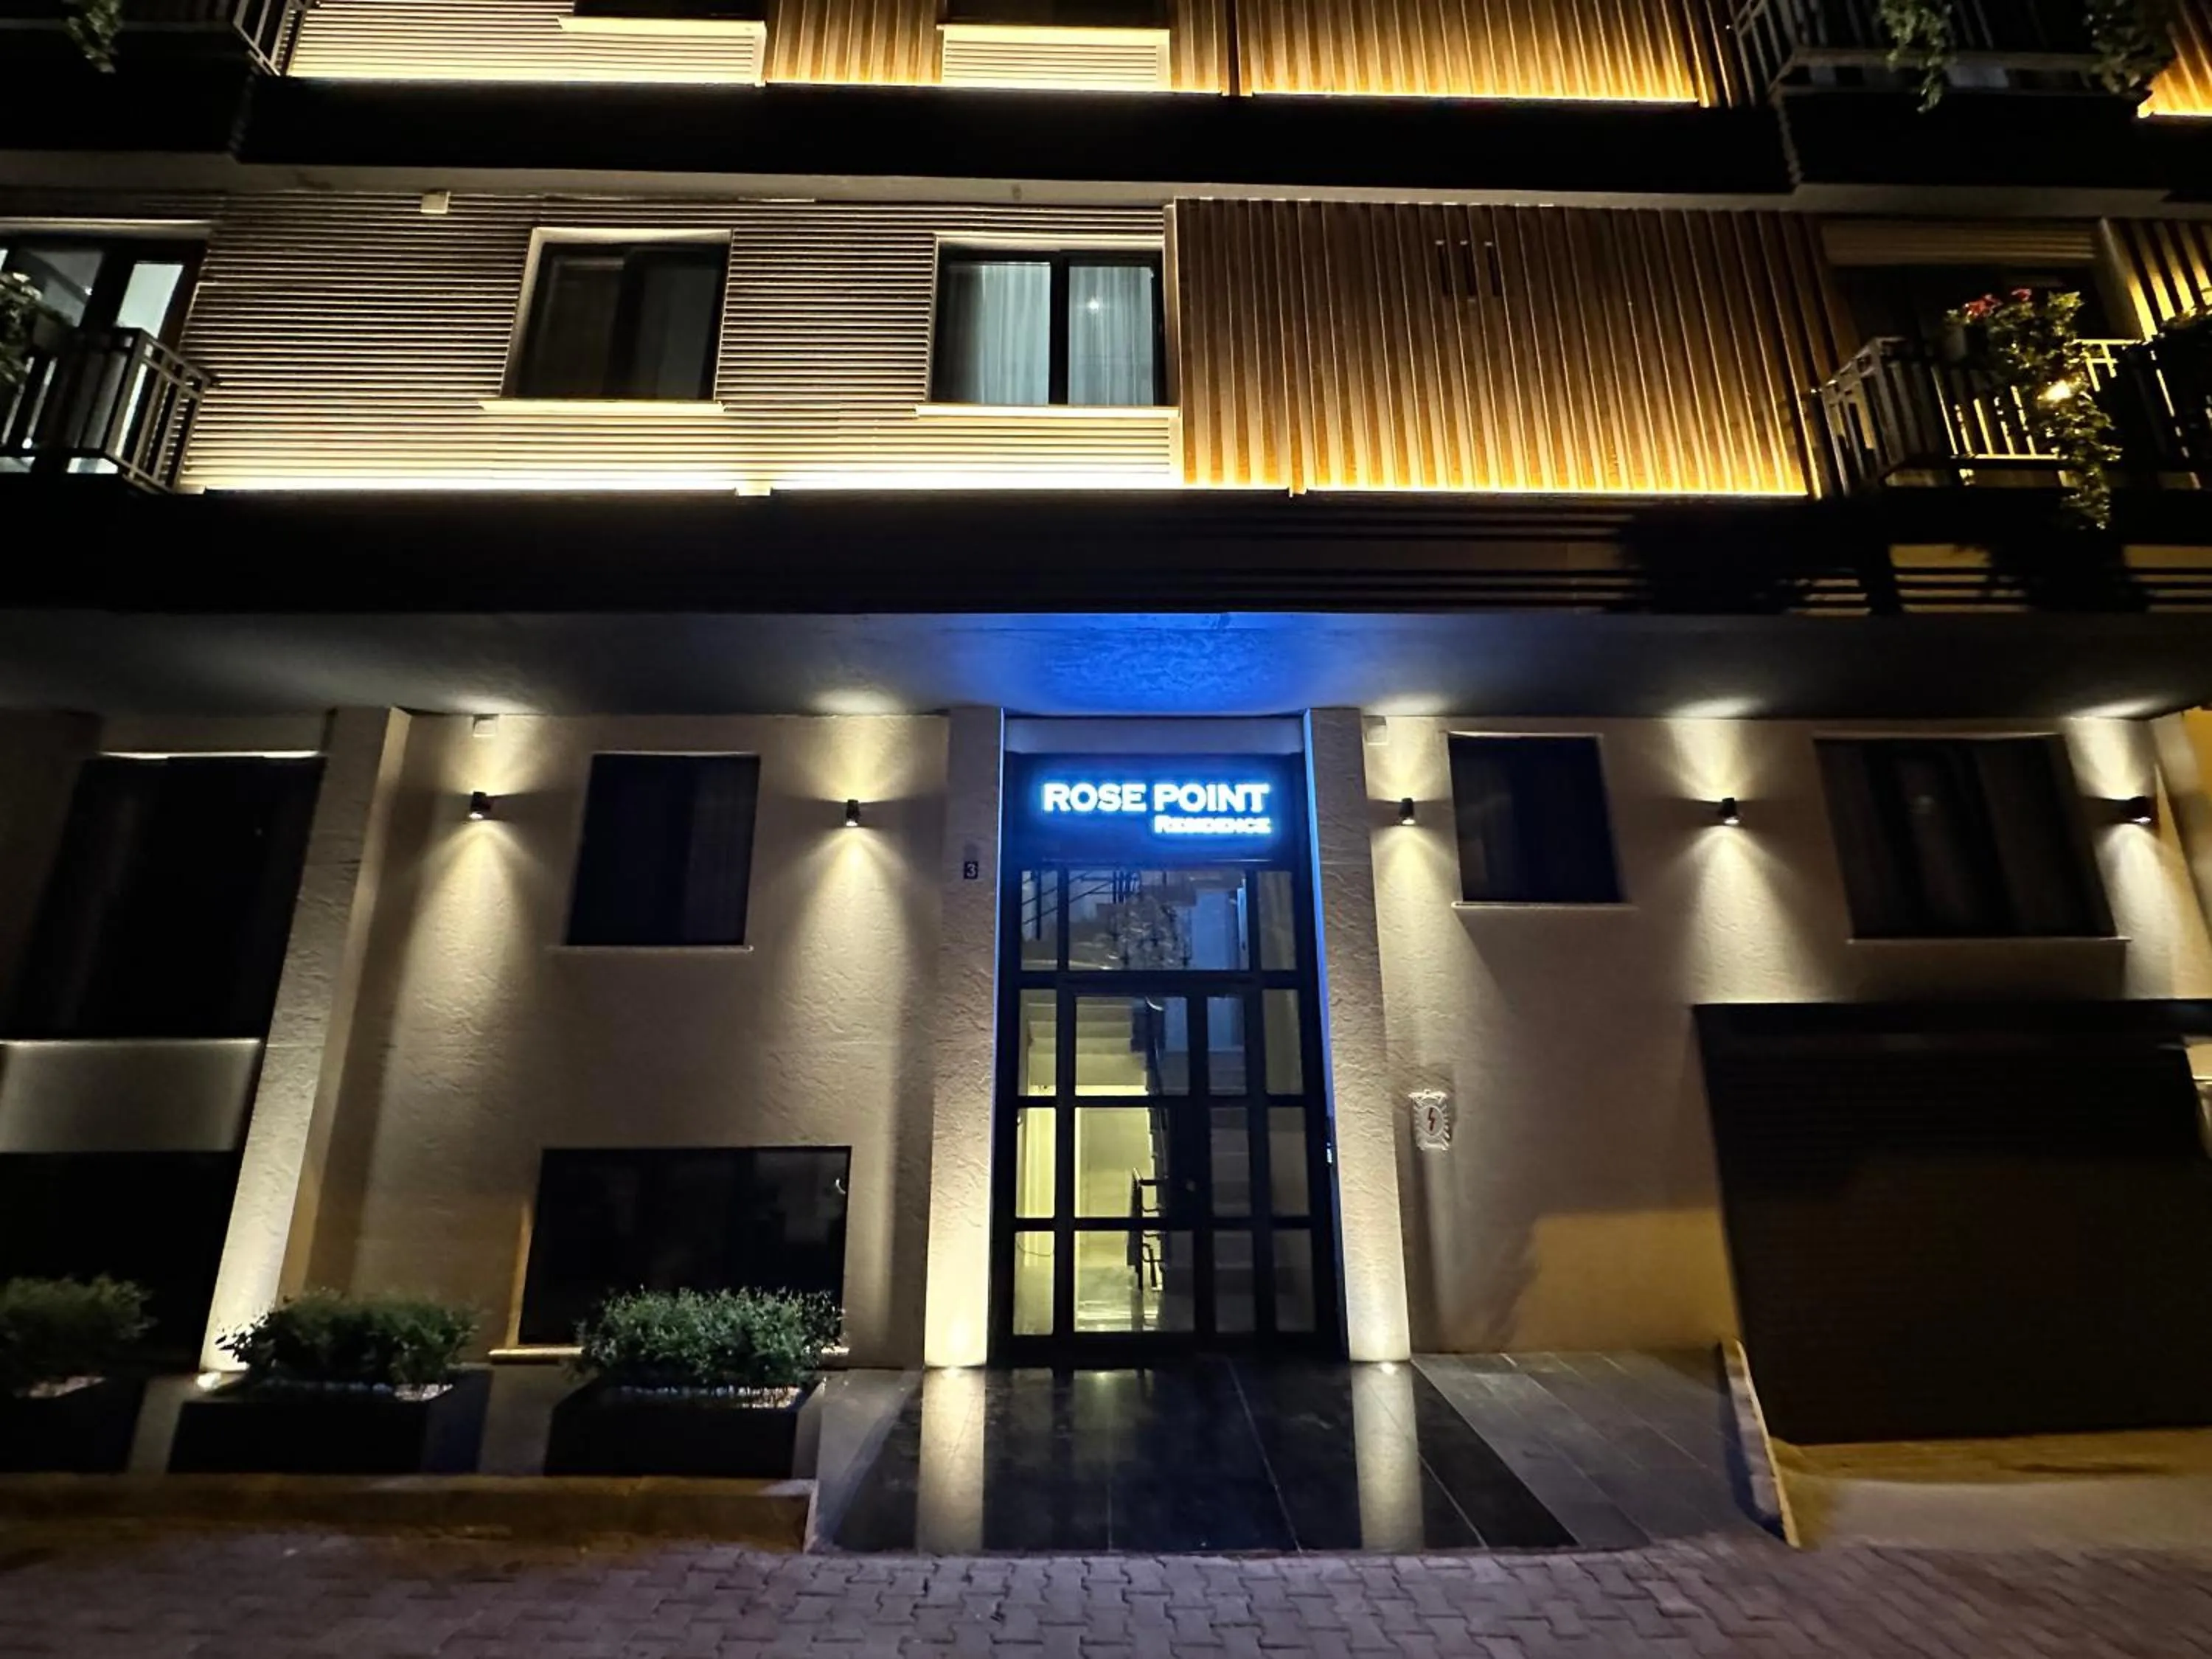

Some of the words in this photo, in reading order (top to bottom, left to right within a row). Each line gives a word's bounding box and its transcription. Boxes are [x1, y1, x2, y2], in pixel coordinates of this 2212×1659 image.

[1043, 782, 1147, 812] ROSE
[1153, 783, 1270, 813] POINT
[967, 863, 976, 877] 3
